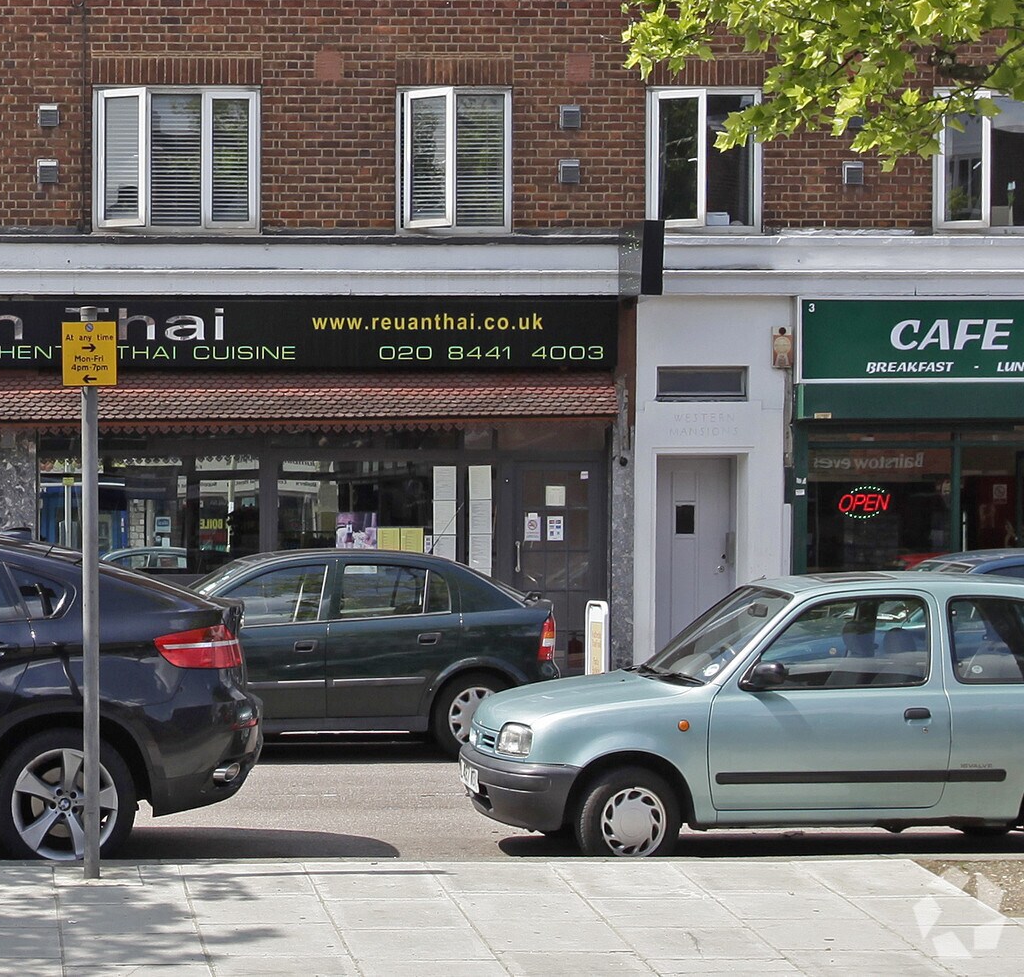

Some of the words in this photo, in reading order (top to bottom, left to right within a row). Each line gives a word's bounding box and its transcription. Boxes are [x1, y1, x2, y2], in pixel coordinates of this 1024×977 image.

[808, 303, 816, 312] 3
[312, 313, 544, 331] www.reuanthai.co.uk
[890, 319, 1014, 350] CAFE
[116, 345, 177, 360] THAI
[192, 345, 296, 360] CUISINE
[378, 345, 433, 360] 020
[447, 345, 512, 361] 8441
[531, 345, 605, 360] 4003
[71, 364, 109, 372] 4pm-7pm
[866, 361, 955, 374] BREAKFAST
[673, 413, 735, 423] WESTERN
[838, 494, 891, 512] OPEN
